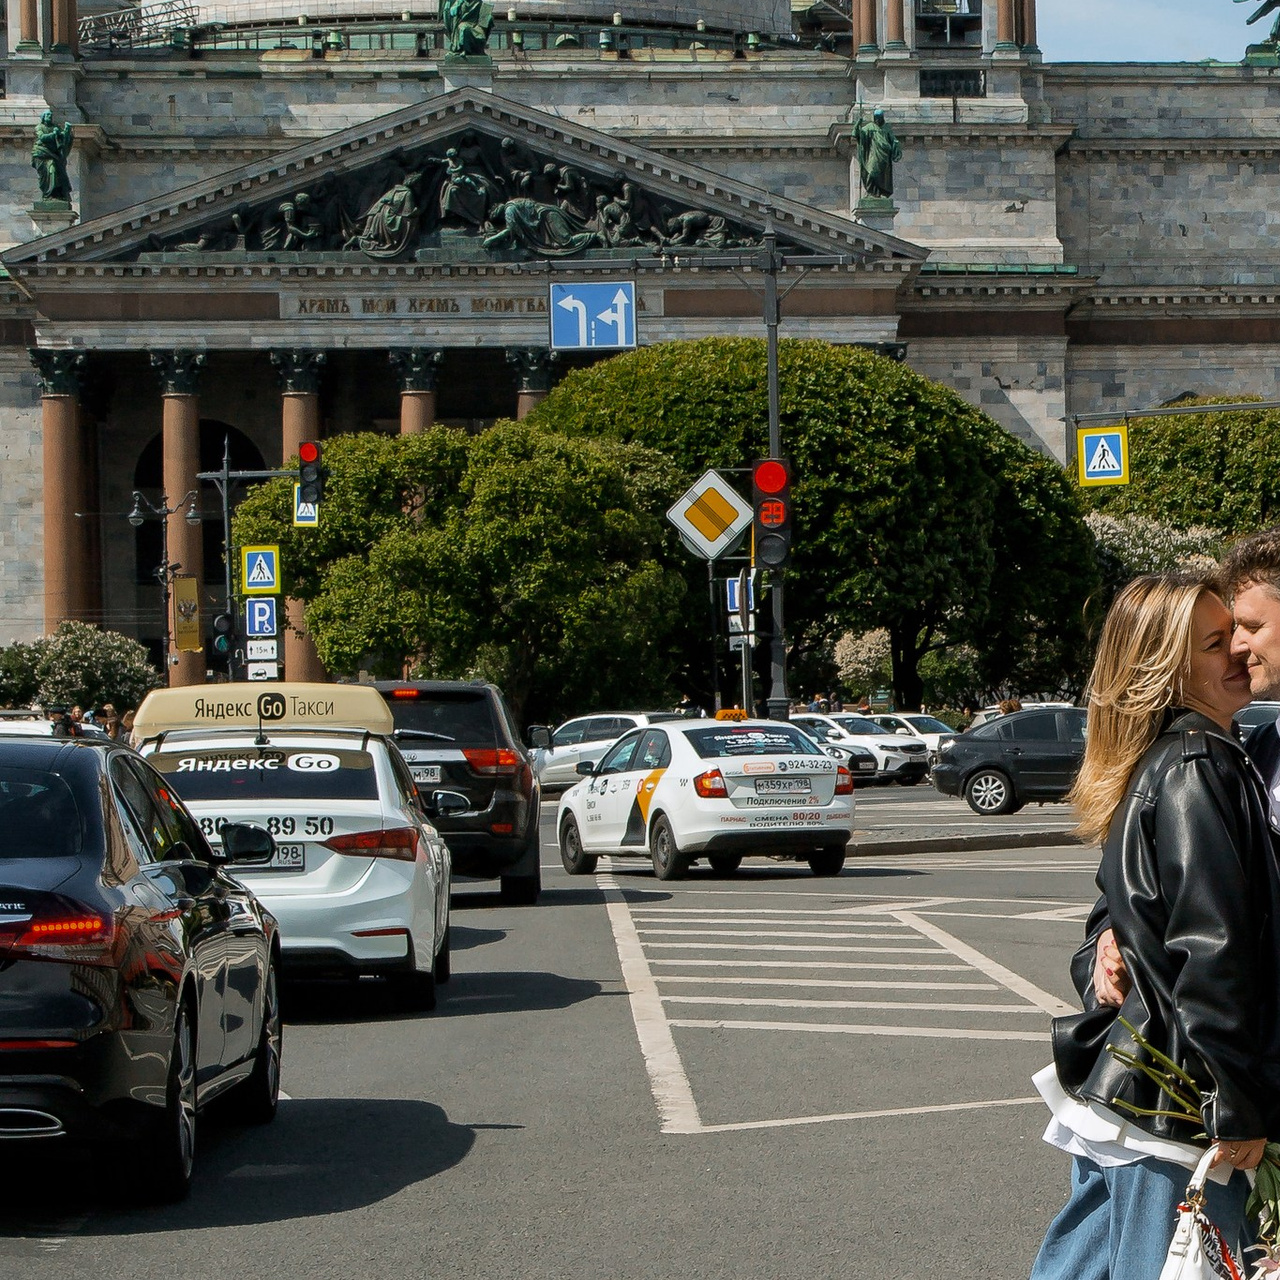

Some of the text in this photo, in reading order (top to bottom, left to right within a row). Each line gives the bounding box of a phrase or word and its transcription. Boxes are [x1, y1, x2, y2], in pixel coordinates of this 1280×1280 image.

[195, 696, 334, 719] Яндекс Go Такси
[176, 758, 280, 772] Яндекс
[295, 756, 333, 770] Go
[788, 760, 833, 770] 924-32-23
[746, 796, 820, 805] Подключение 2%
[792, 812, 821, 820] 80/20
[266, 817, 296, 835] 89
[305, 817, 334, 835] 50
[276, 847, 299, 860] 198
